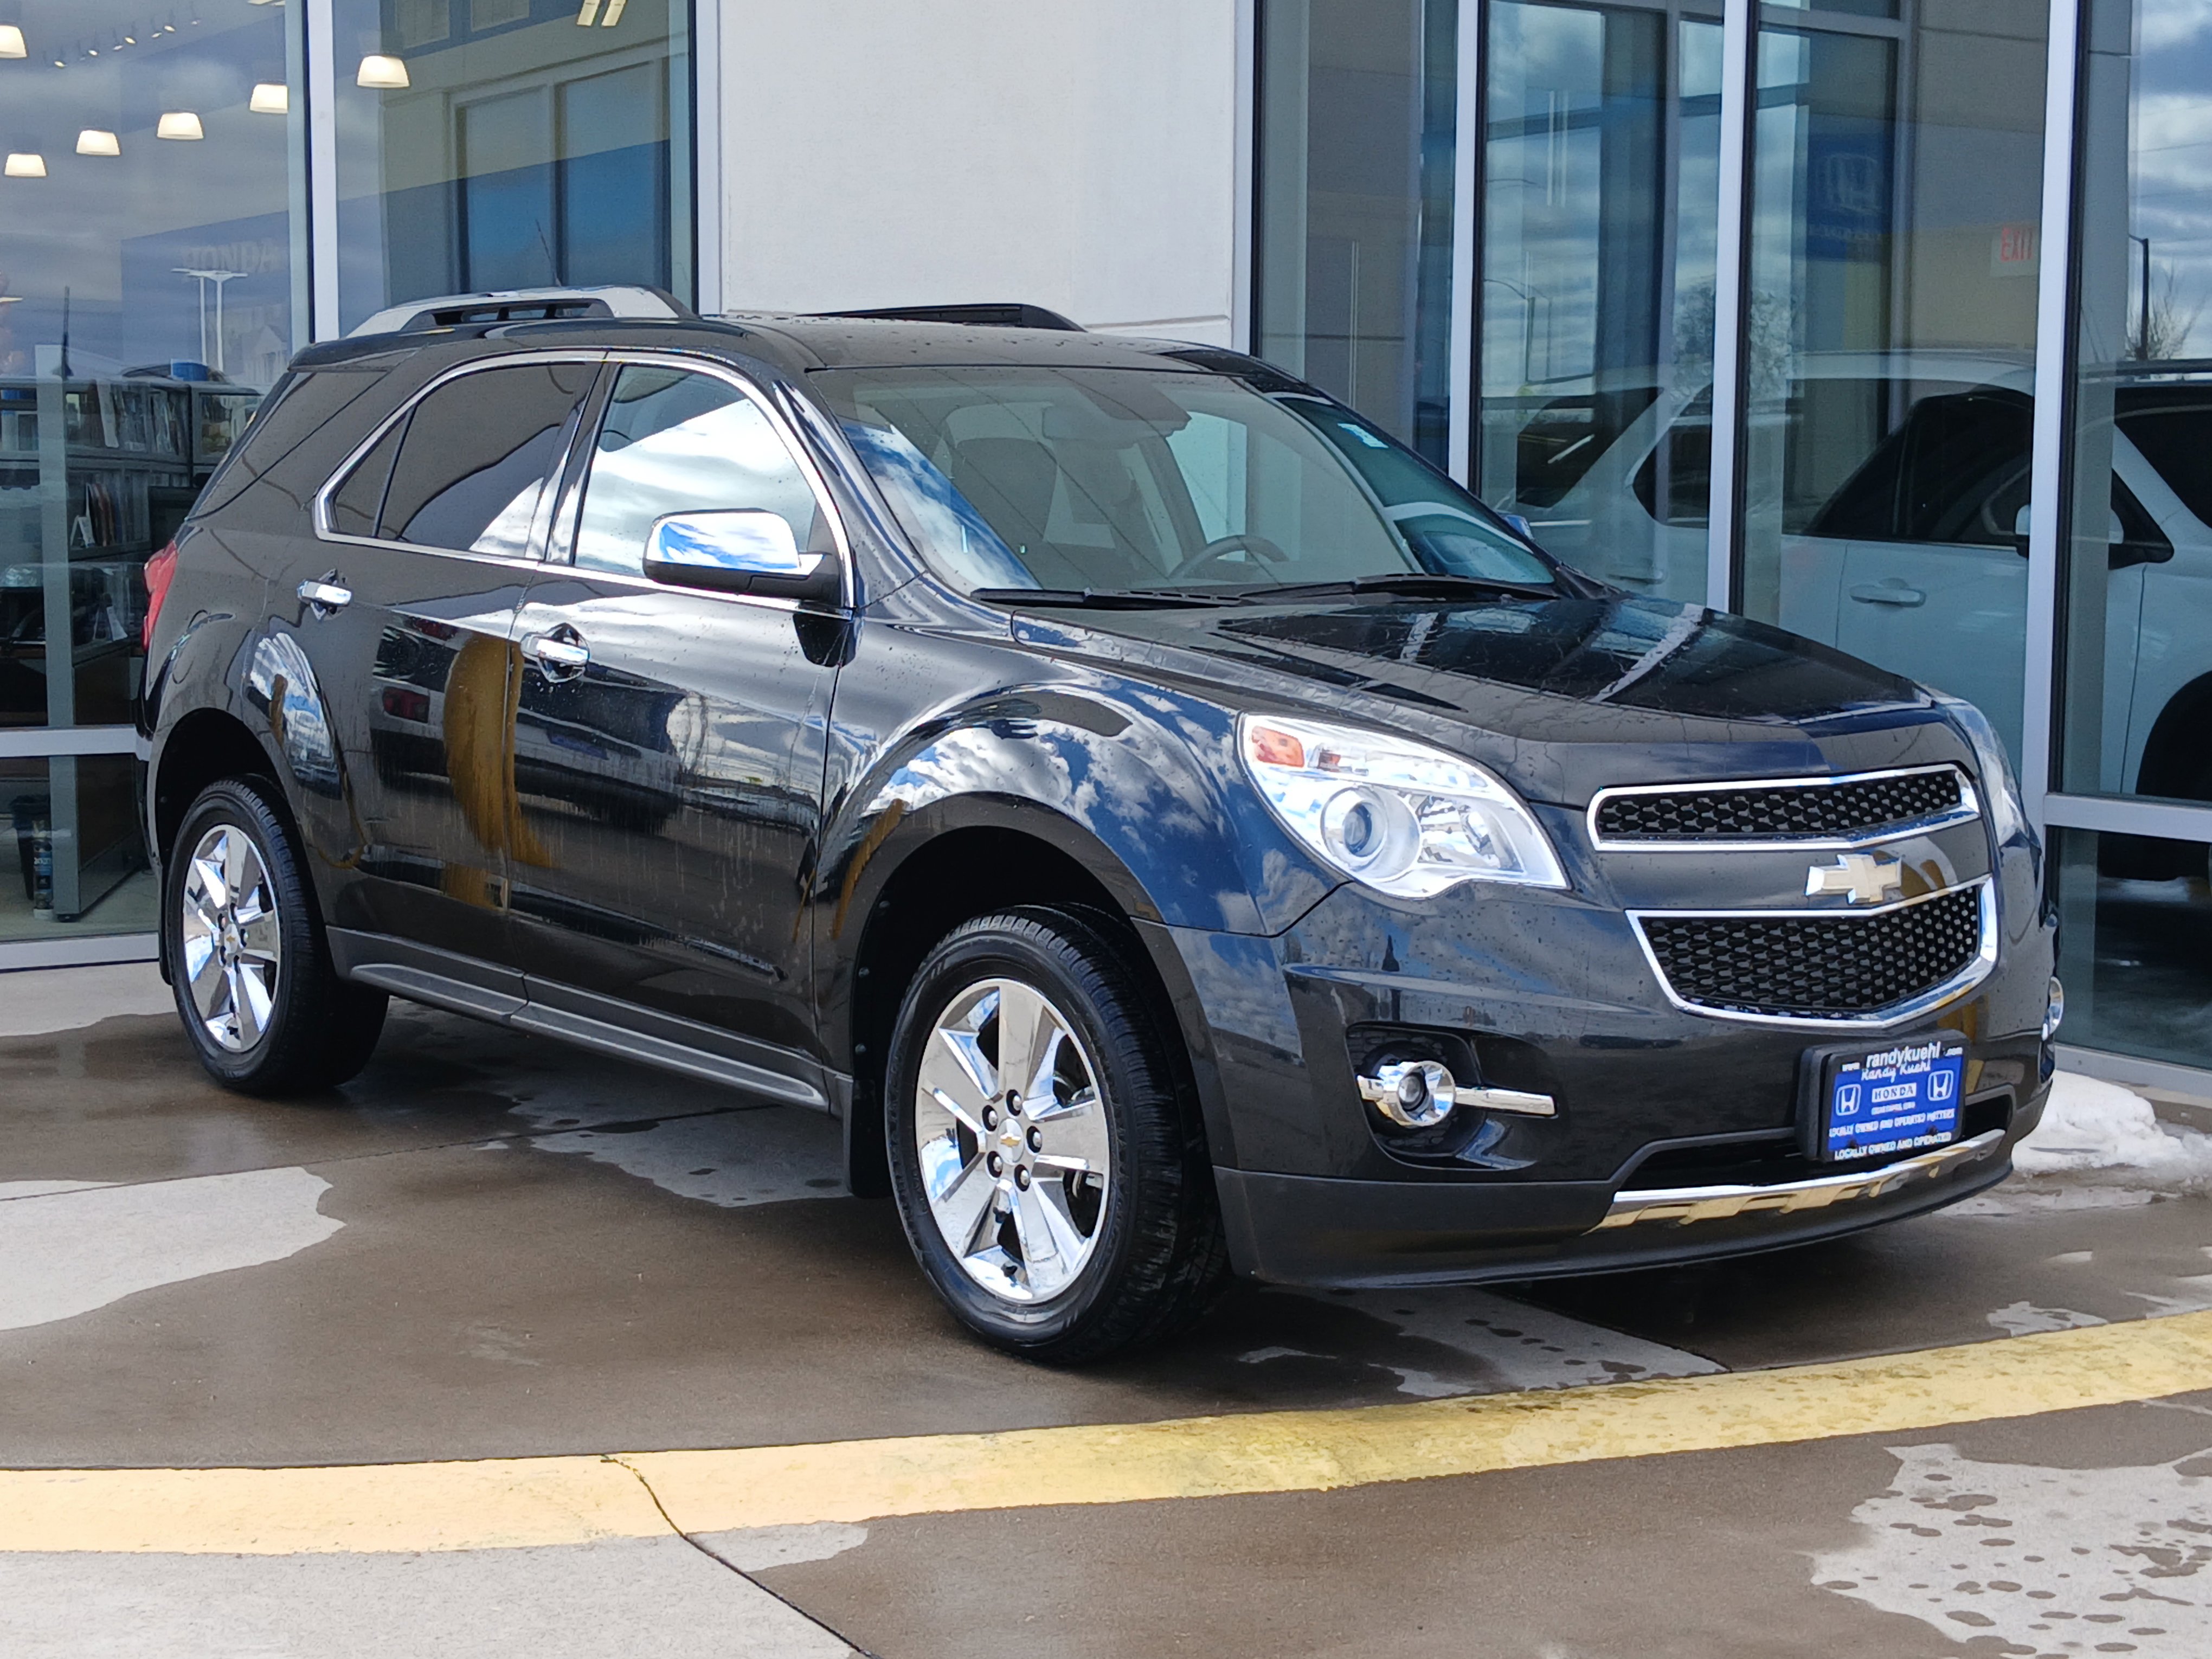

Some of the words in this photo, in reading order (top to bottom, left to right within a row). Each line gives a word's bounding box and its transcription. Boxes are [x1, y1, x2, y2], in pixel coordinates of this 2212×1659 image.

[2001, 227, 2033, 262] EXIT
[1866, 1041, 1941, 1068] randykuehl
[1861, 1068, 1896, 1083] Randy
[1900, 1059, 1931, 1075] Kuehl
[1874, 1085, 1914, 1100] HONDA
[1835, 1146, 1868, 1160] LOCALLY
